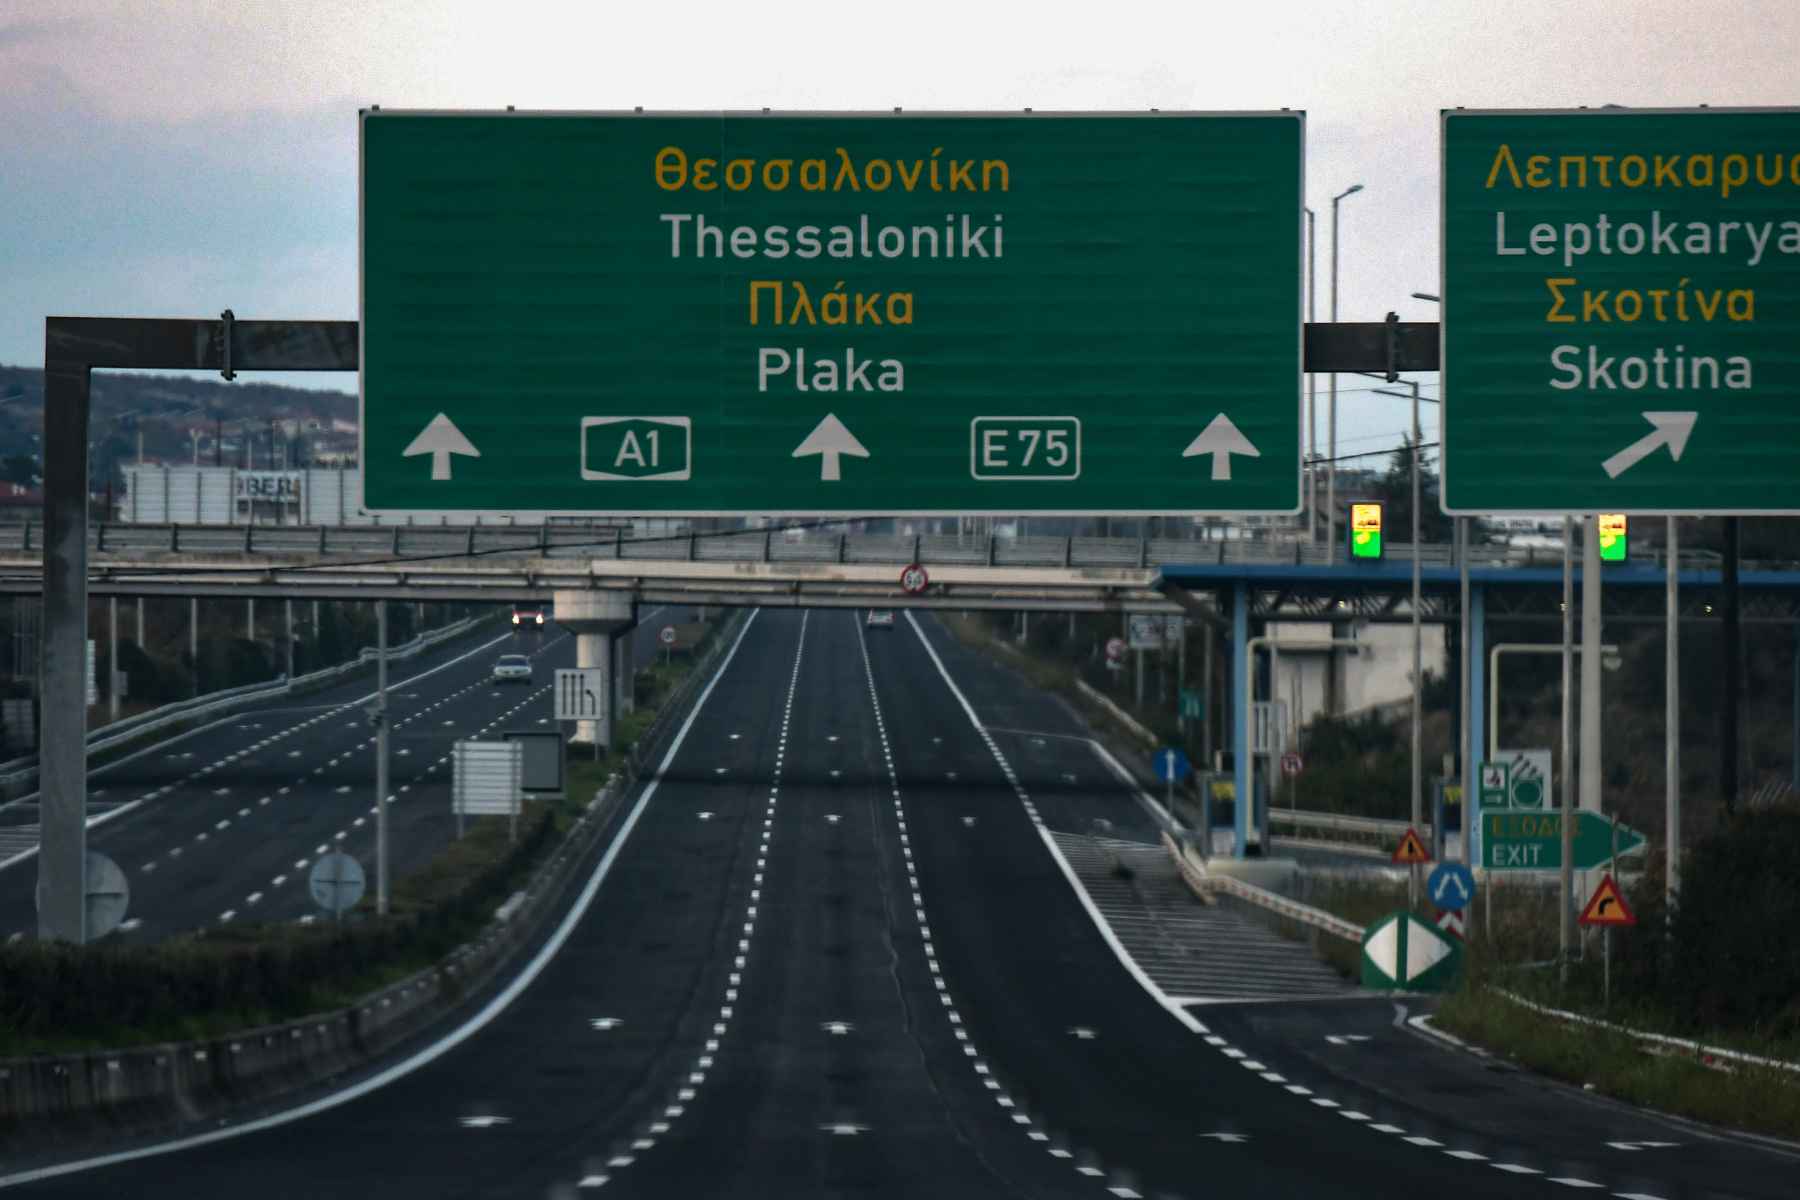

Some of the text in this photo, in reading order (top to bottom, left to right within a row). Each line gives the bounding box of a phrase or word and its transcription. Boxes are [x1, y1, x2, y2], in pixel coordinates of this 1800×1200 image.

[655, 147, 1010, 191] Θεσσαλονίκη
[660, 213, 1004, 258] Thessaloniki
[1496, 210, 1800, 266] Leptokarya
[749, 280, 914, 325] Πλάκα
[1546, 276, 1755, 323] Σκοτίνα
[758, 347, 904, 392] Plaka
[1549, 344, 1752, 390] Skotina
[614, 429, 660, 468] A1
[1491, 843, 1543, 865] EXIT
